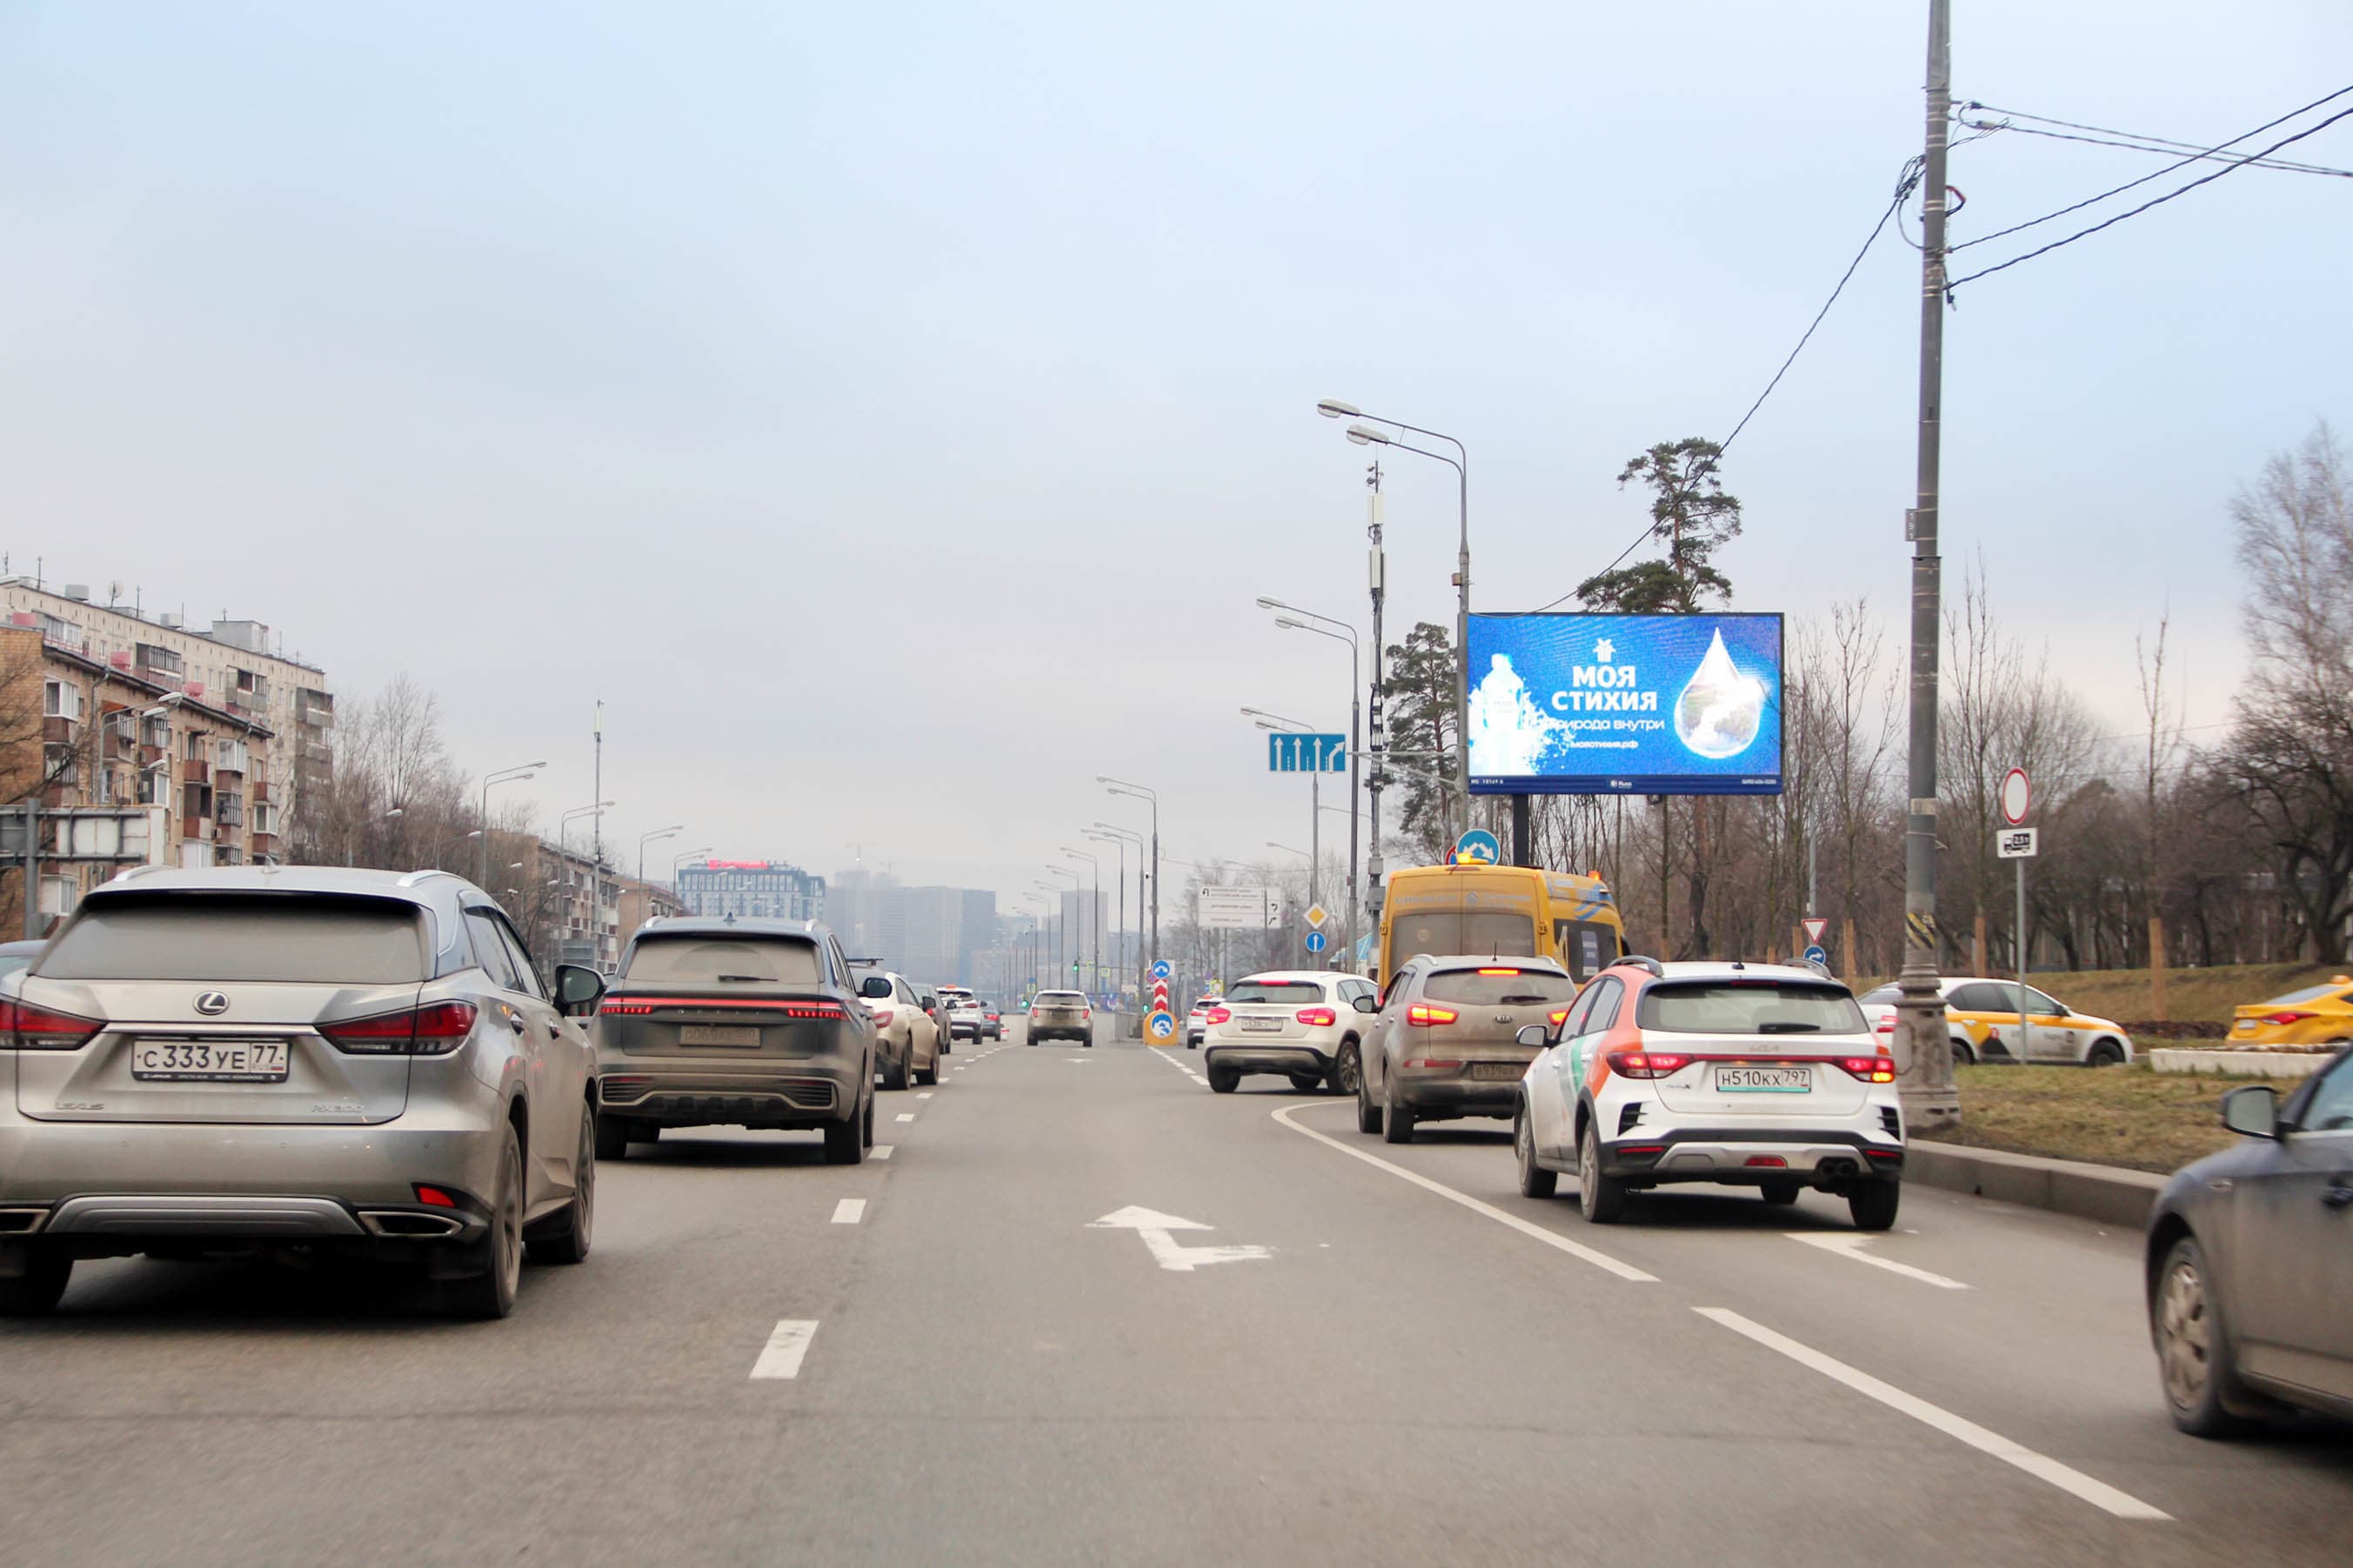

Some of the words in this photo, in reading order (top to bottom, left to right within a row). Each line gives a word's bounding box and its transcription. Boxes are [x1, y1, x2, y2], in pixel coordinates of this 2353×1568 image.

[1572, 665, 1636, 688] МОЯ
[1551, 691, 1658, 711] СТИХИЯ
[1548, 719, 1611, 731] рирода
[1613, 719, 1666, 731] внутри
[253, 1045, 278, 1063] 77
[1783, 1071, 1807, 1083] 797
